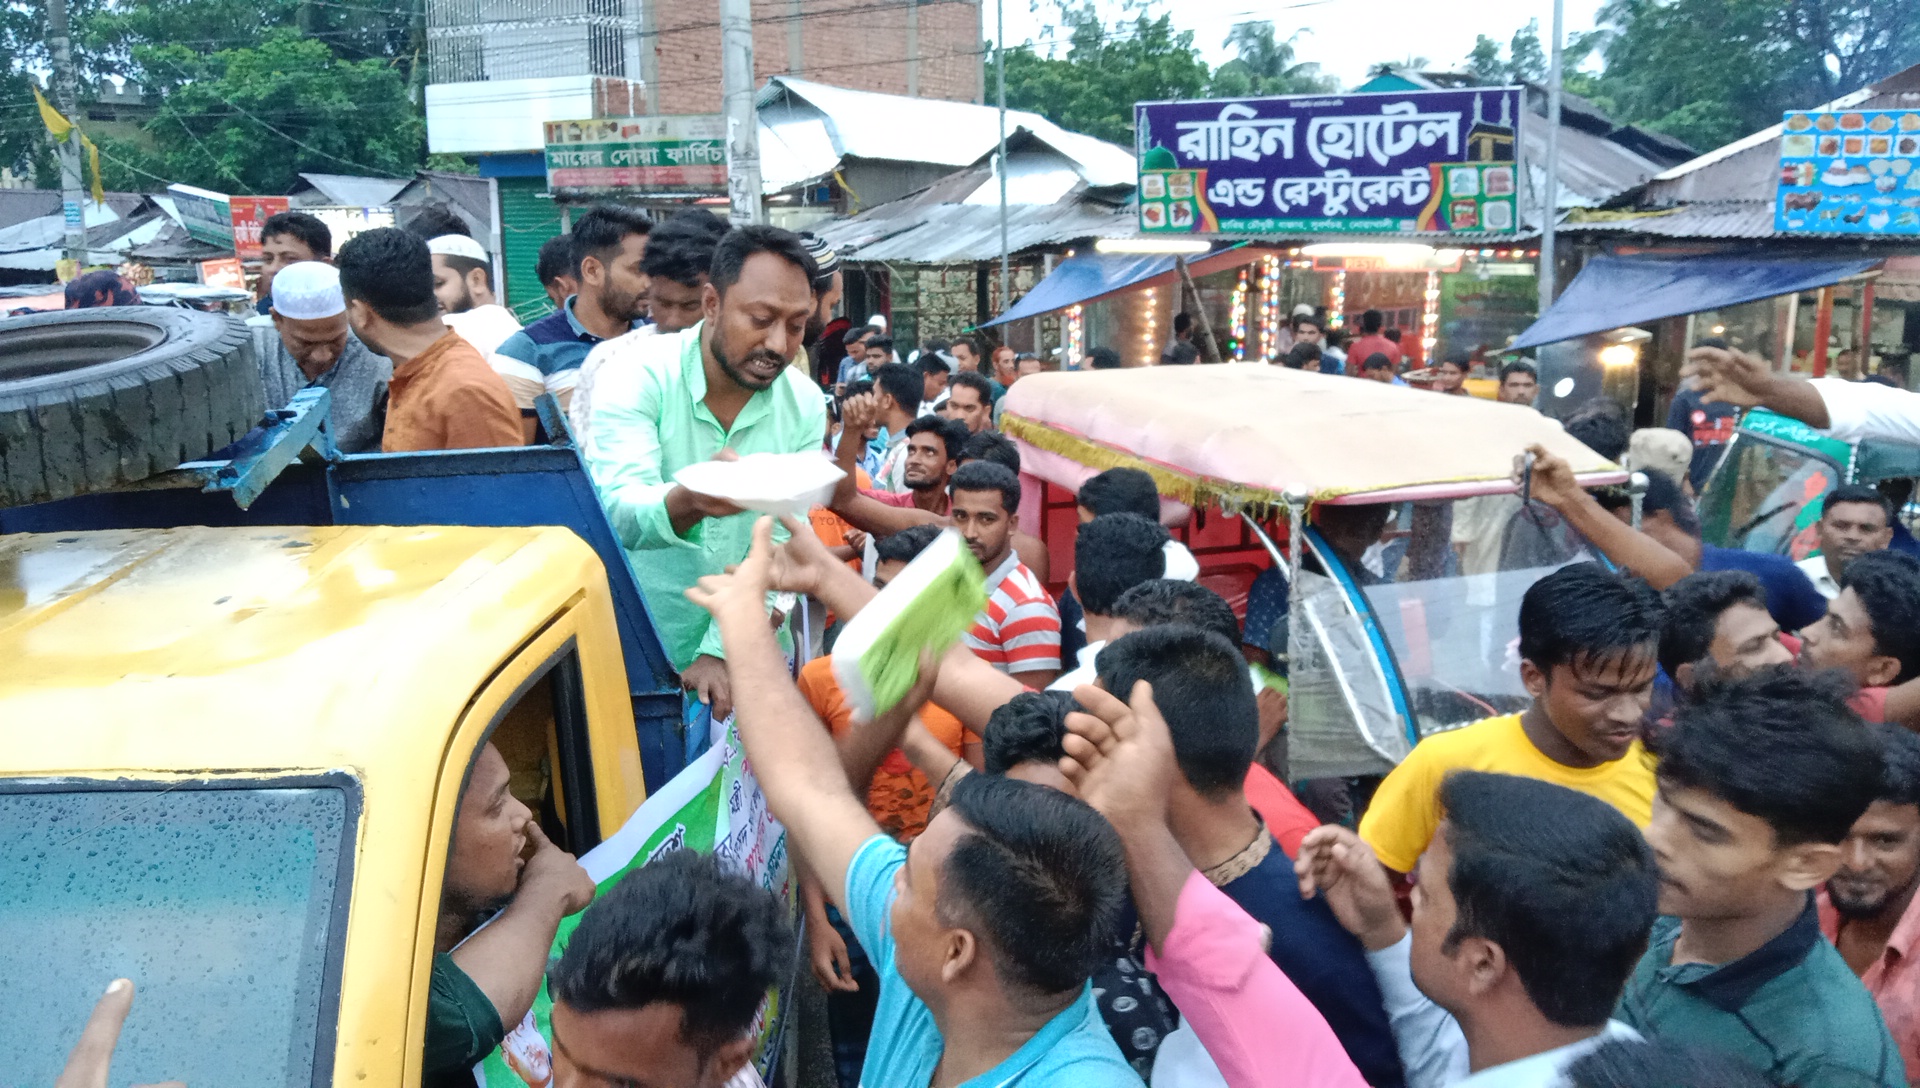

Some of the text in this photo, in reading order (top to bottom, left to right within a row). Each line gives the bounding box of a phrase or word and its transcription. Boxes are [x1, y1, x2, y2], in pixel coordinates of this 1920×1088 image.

[550, 151, 603, 165] মায়ের
[610, 146, 659, 165] দোয়া
[1175, 102, 1462, 168] রাহিন হোটেল
[1208, 166, 1432, 216] এন্ড রেস্টুরেন্ট
